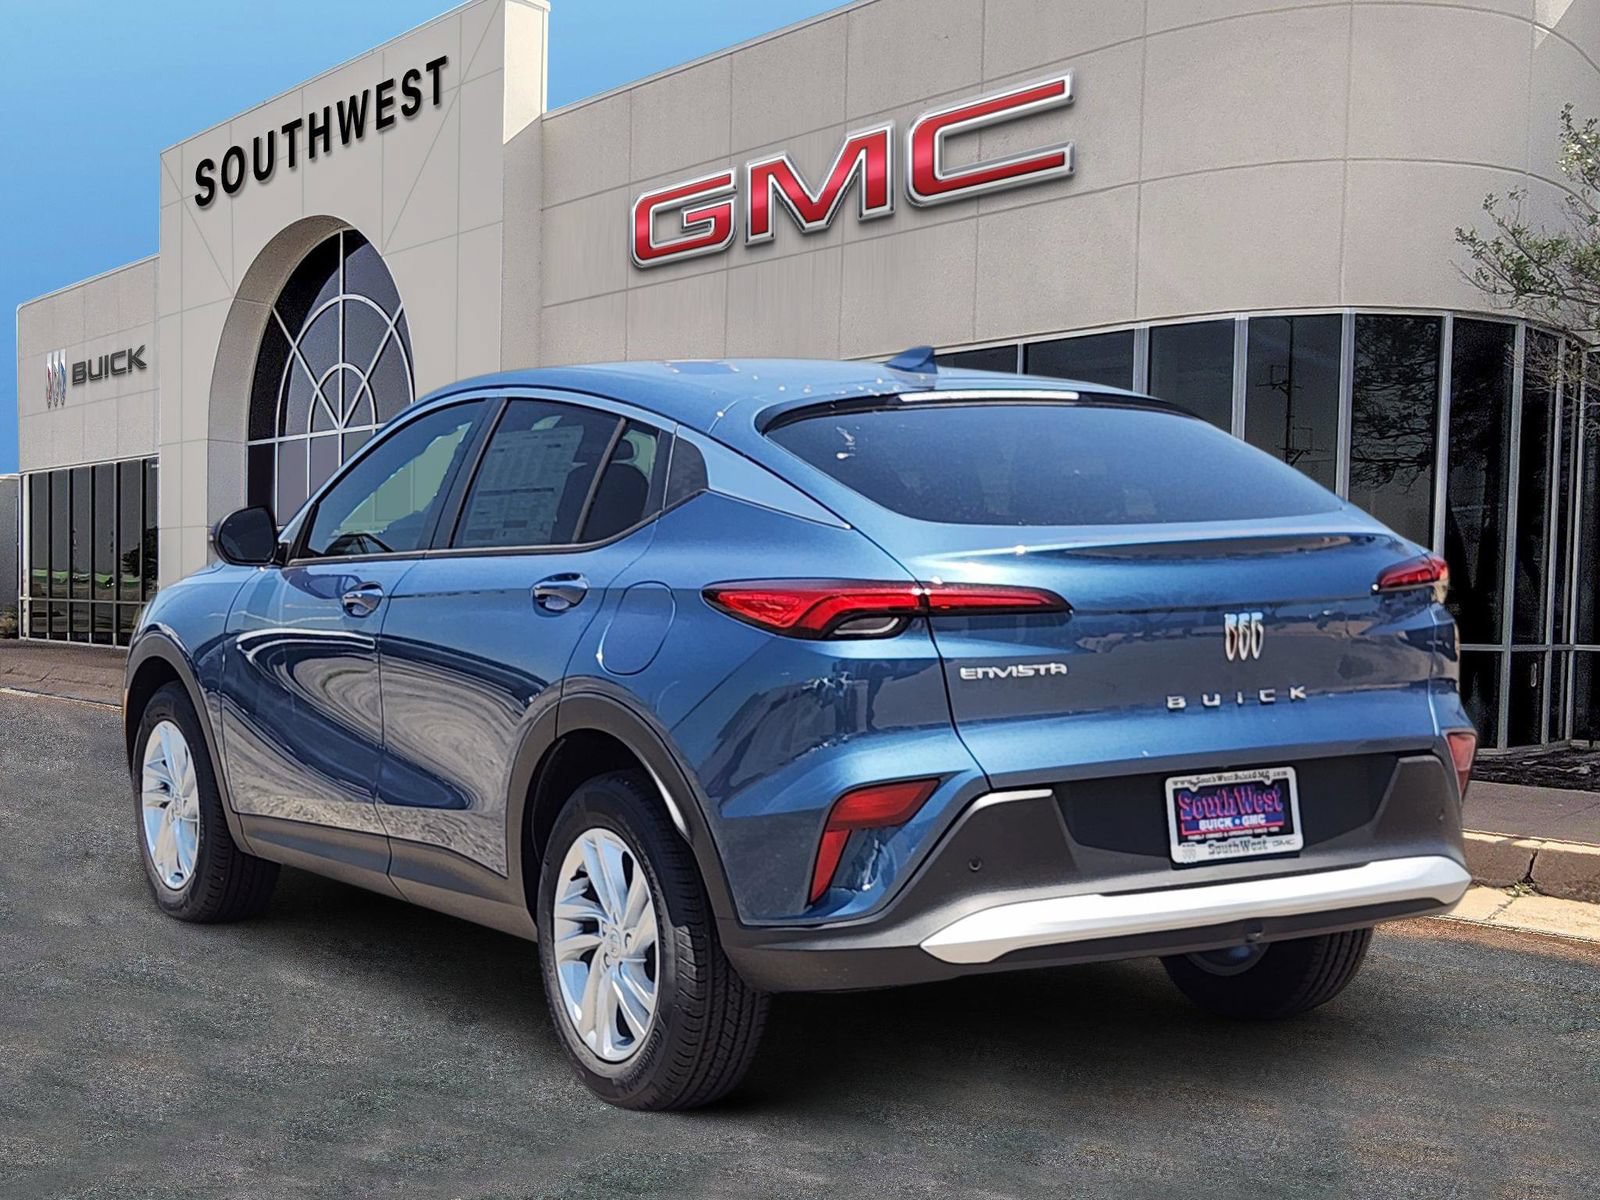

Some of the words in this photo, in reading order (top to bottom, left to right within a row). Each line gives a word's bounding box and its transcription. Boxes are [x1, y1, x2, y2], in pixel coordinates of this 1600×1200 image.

[194, 55, 448, 207] SOUTHWEST
[630, 68, 1076, 269] GMC
[71, 344, 148, 387] BUICK
[959, 662, 1068, 680] ENVISTA
[1166, 685, 1307, 710] BUICK
[1199, 815, 1233, 831] BUICK
[1241, 813, 1267, 826] GMC
